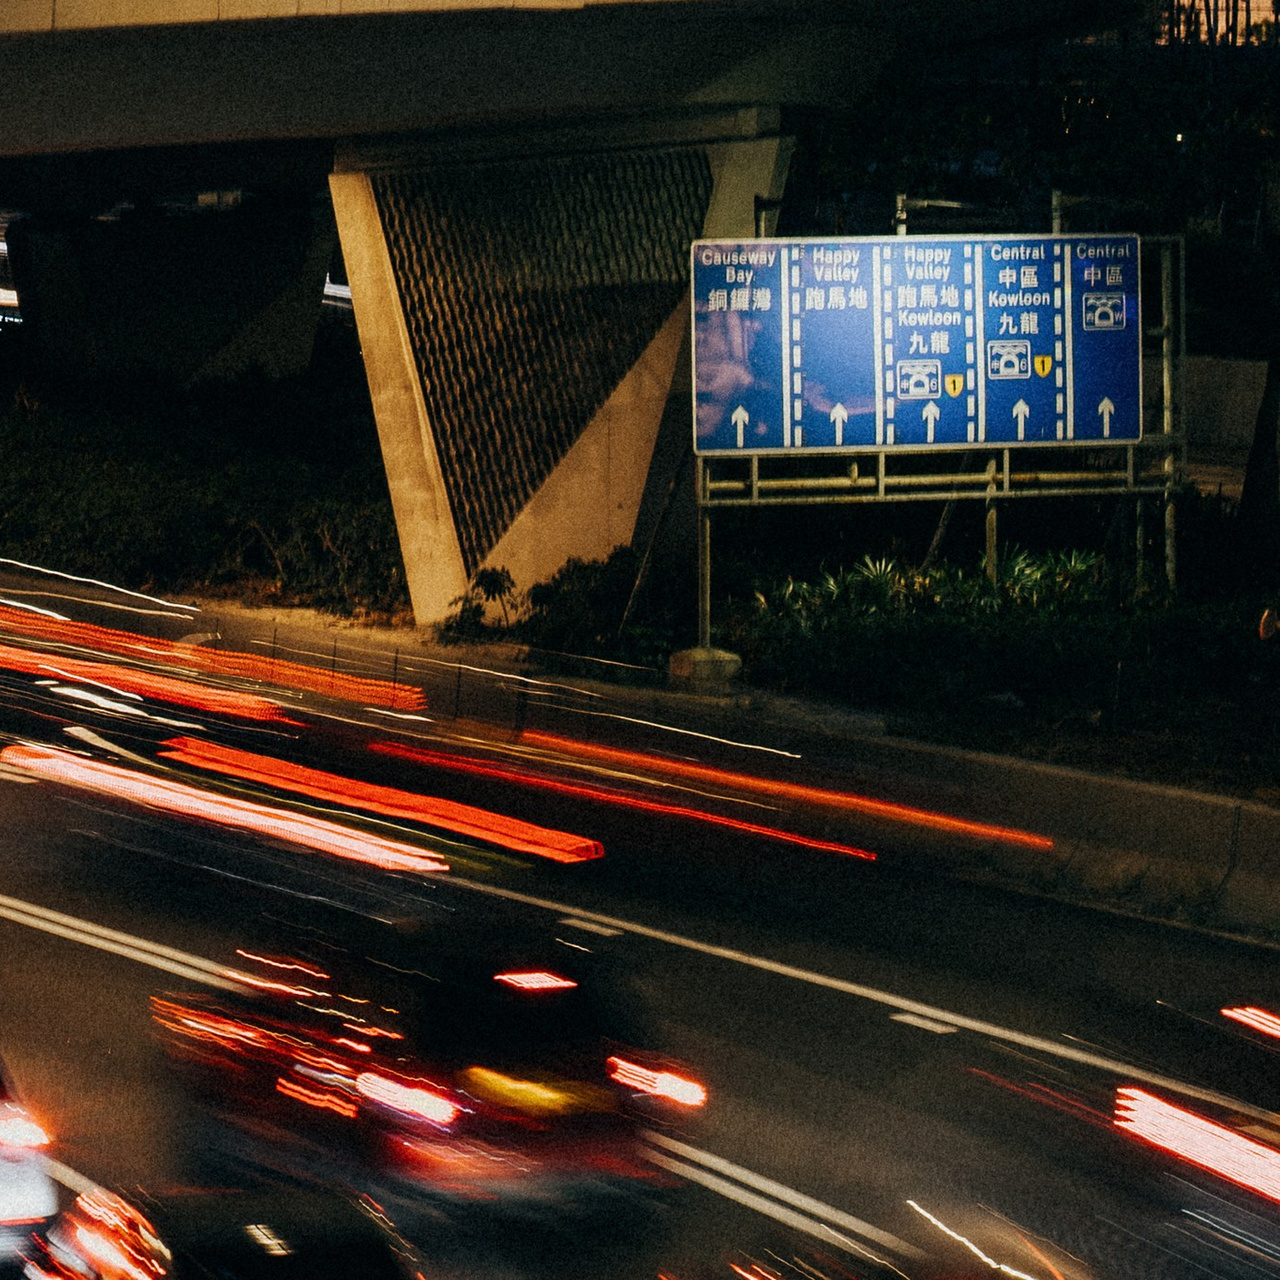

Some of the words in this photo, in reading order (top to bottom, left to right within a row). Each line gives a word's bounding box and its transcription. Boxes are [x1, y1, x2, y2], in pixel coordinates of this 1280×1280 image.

[701, 248, 776, 268] Causeway
[813, 246, 860, 269] Happy
[904, 245, 952, 265] Happy
[991, 244, 1045, 261] Central
[1076, 243, 1130, 260] Central
[725, 267, 754, 285] Bay
[814, 265, 860, 283] Valley
[905, 262, 951, 282] Valley
[998, 265, 1039, 289] 中區
[1084, 264, 1123, 287] 中區
[708, 287, 772, 312] 銅鑼灣
[805, 286, 868, 310] 跑馬地
[898, 284, 959, 309] 跑馬地
[988, 289, 1051, 308] Kowloon
[898, 308, 962, 327] Kowloon
[998, 311, 1039, 336] 九龍
[909, 330, 950, 355] 九龍
